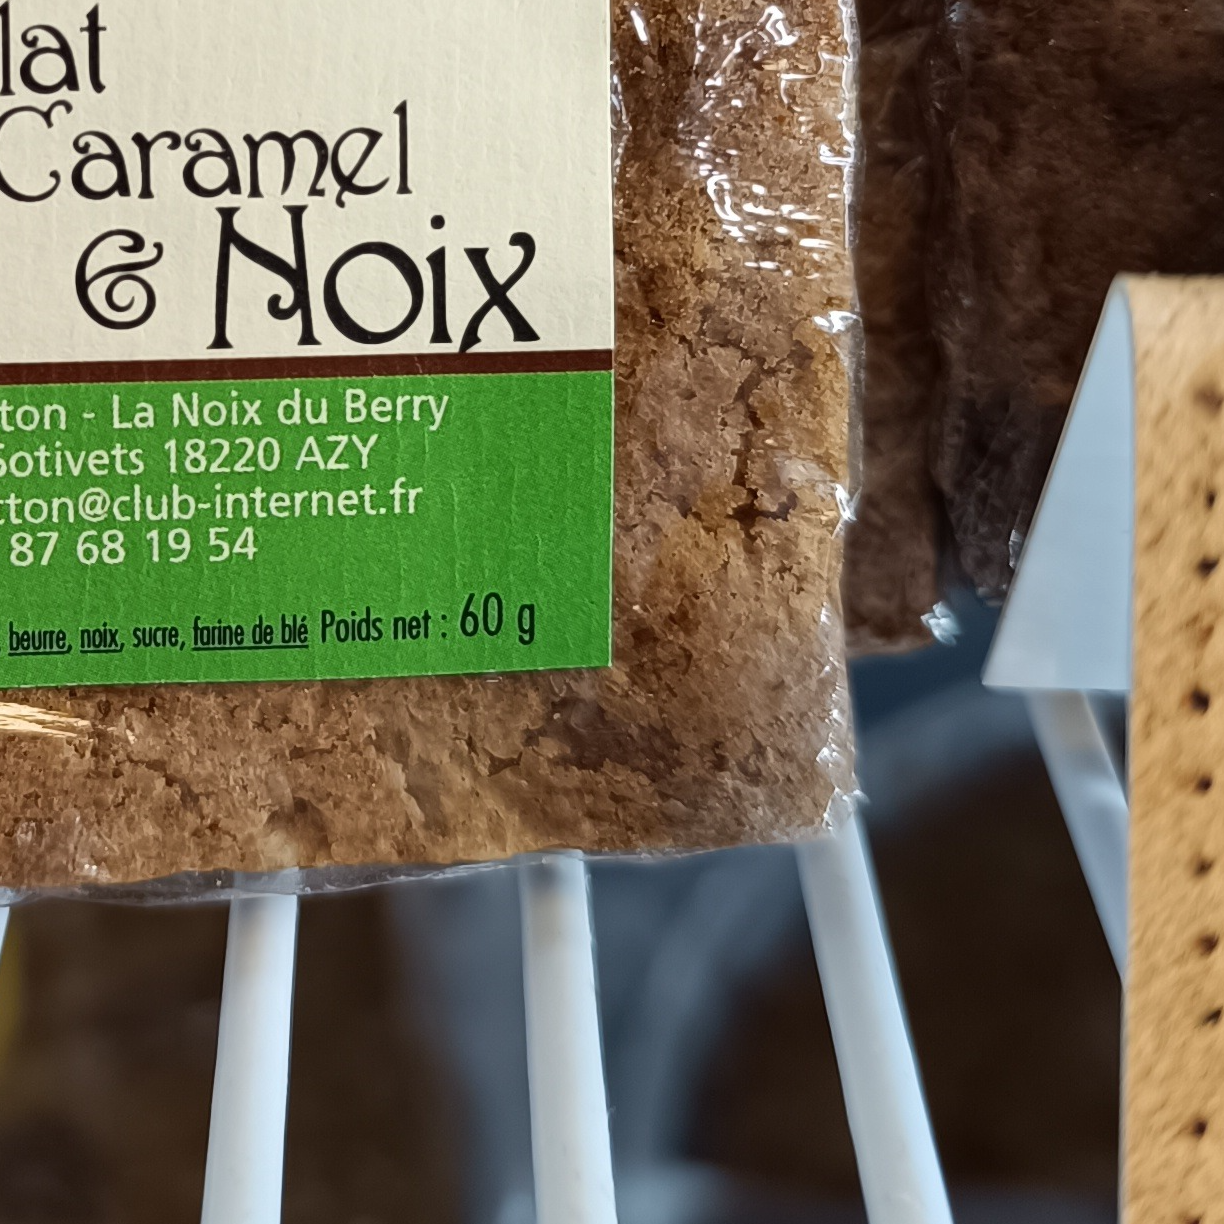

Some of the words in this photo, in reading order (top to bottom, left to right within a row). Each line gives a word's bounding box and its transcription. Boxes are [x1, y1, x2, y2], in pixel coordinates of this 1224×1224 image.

[73, 226, 164, 329] &
[205, 203, 543, 353] Noix
[112, 393, 155, 429] La
[172, 390, 263, 427] Noix
[277, 388, 328, 425] du
[344, 388, 449, 431] Berry
[164, 437, 281, 473] 18220
[294, 434, 379, 470] AZY
[9, 531, 59, 567] 87
[76, 529, 126, 565] 68
[145, 528, 191, 563] 19
[208, 526, 258, 562] 54
[7, 621, 73, 656] beurre,
[79, 621, 125, 654] noix,
[132, 625, 187, 652] sucre,
[191, 615, 245, 652] farine
[251, 613, 274, 650] de
[280, 612, 309, 649] blé
[320, 605, 384, 644] Poids
[392, 608, 432, 640] net
[459, 591, 505, 638] 60
[517, 603, 536, 646] g
